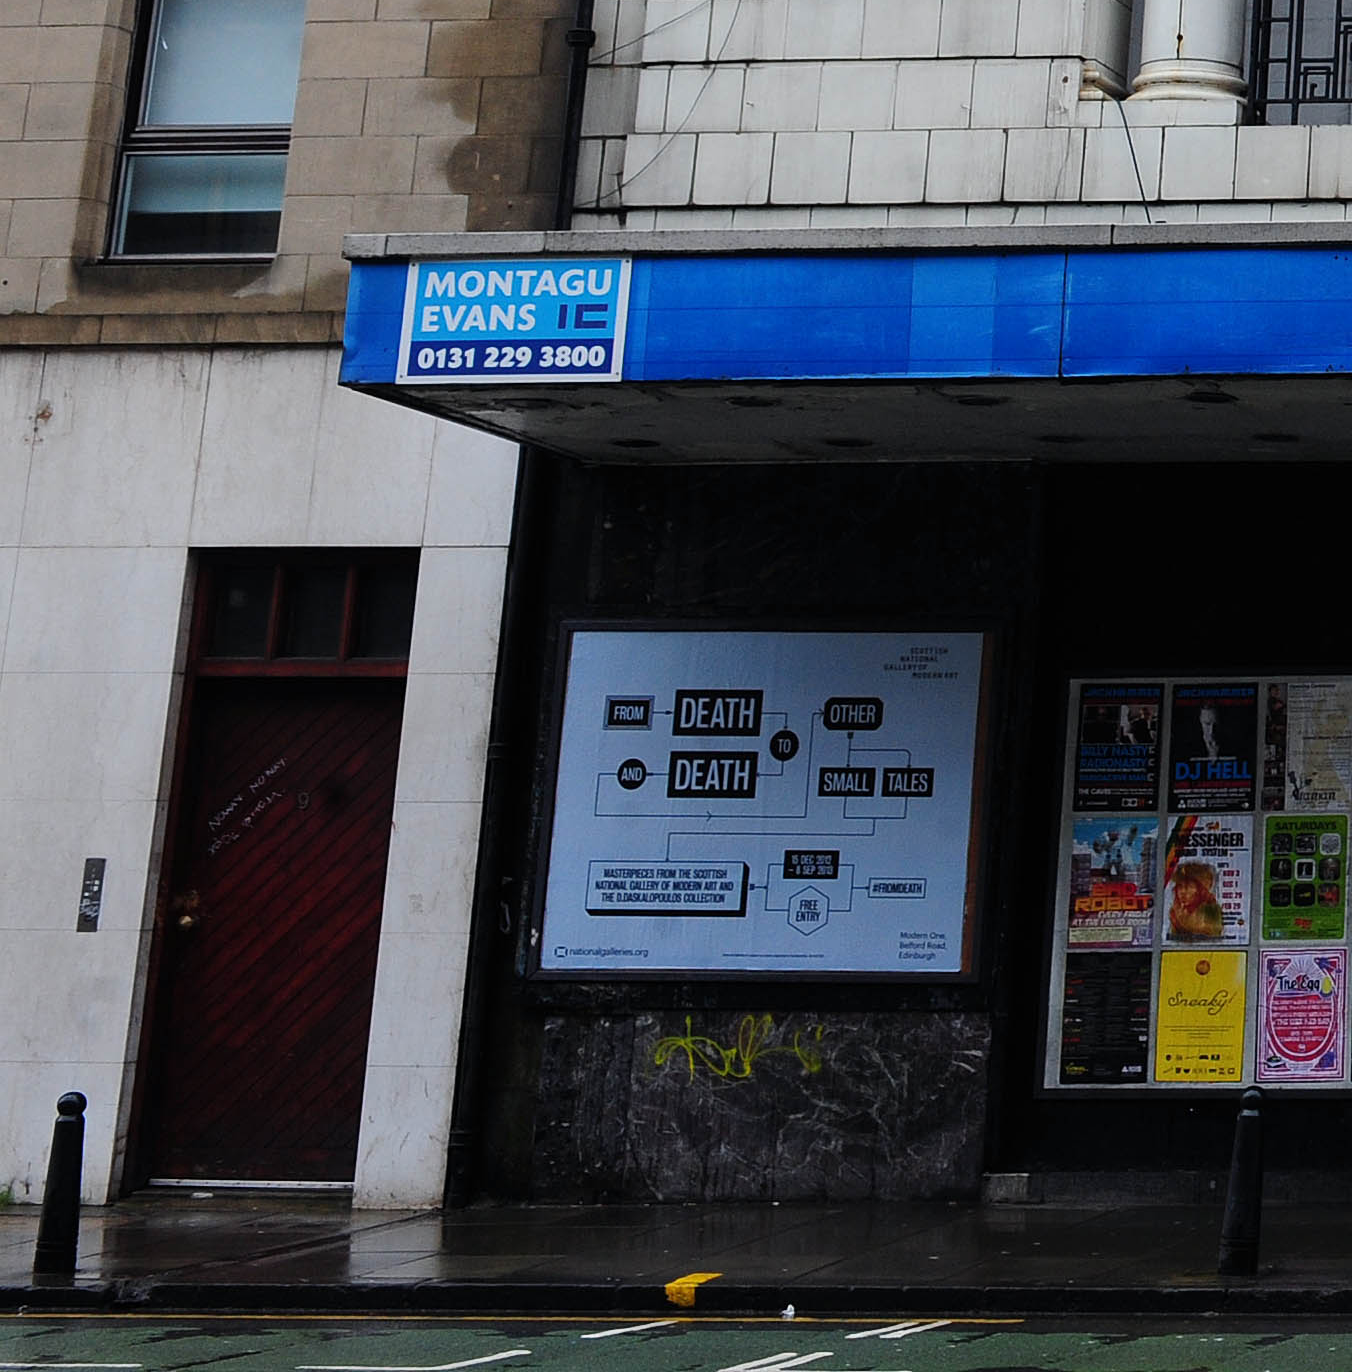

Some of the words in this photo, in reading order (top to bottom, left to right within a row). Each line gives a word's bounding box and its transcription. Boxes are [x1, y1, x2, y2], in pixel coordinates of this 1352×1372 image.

[424, 269, 612, 298] MONTAGU
[420, 303, 536, 332] EVANS
[417, 346, 476, 369] 0131
[483, 346, 532, 368] 229
[539, 345, 606, 368] 3800
[613, 705, 645, 721] FROM
[680, 697, 755, 729] DEATH
[829, 704, 877, 724] OTHER
[776, 738, 792, 754] TO
[621, 768, 642, 782] AND
[674, 759, 750, 791] DEATH
[1175, 761, 1200, 779] DJ
[1207, 760, 1253, 780] HELL
[823, 772, 870, 792] SMALL
[887, 772, 929, 792] TALES
[604, 869, 655, 878] MASTERPIECES
[693, 869, 727, 878] SCOTTISH
[595, 881, 627, 890] NATIONAL
[629, 881, 659, 890] GALLERY
[673, 881, 702, 890] MODERN
[704, 881, 717, 890] ART
[719, 881, 734, 890] AND
[872, 882, 922, 893] #FROMDEATH
[602, 893, 615, 903] THE
[683, 893, 725, 903] COLLECTION
[800, 899, 818, 910] FREE
[795, 911, 821, 922] ENTRY
[569, 945, 649, 958] nationalgalleries.org
[1167, 989, 1237, 1016] Sneaky!
